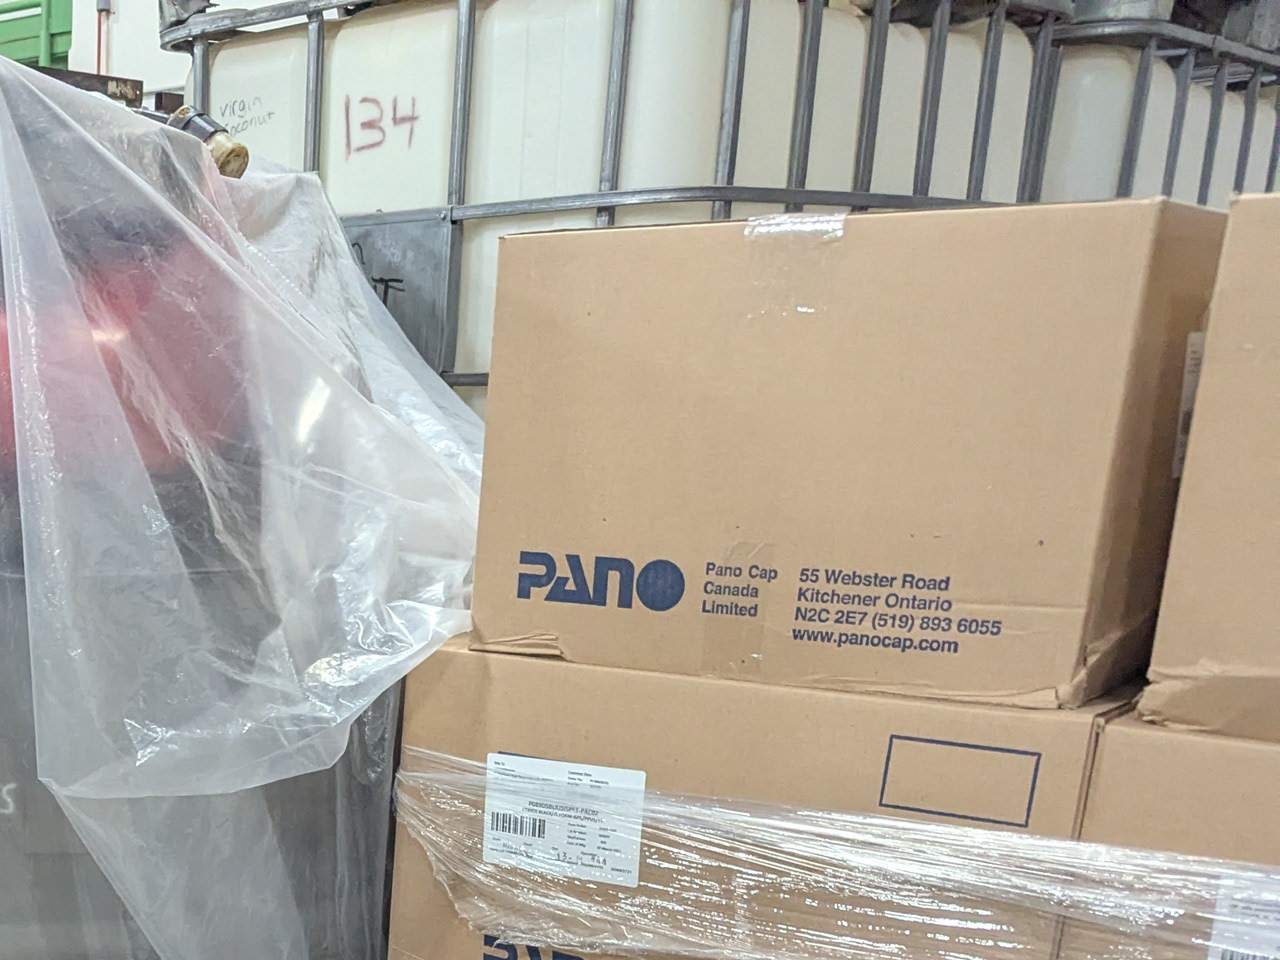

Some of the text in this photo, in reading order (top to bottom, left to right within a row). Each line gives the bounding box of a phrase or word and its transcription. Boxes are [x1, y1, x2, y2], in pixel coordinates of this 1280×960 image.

[224, 111, 275, 136] oconut
[344, 94, 420, 161] 134
[517, 550, 685, 612] PANO
[705, 562, 778, 582] Pano Cap
[799, 568, 950, 592] 55 Webster Road
[703, 582, 759, 599] Canada
[797, 588, 952, 612] Kitchener Ontario
[701, 601, 758, 617] Limited
[794, 607, 1002, 636] N2C 2E7 (519) 893 6055
[792, 628, 959, 654] www.panocap.com
